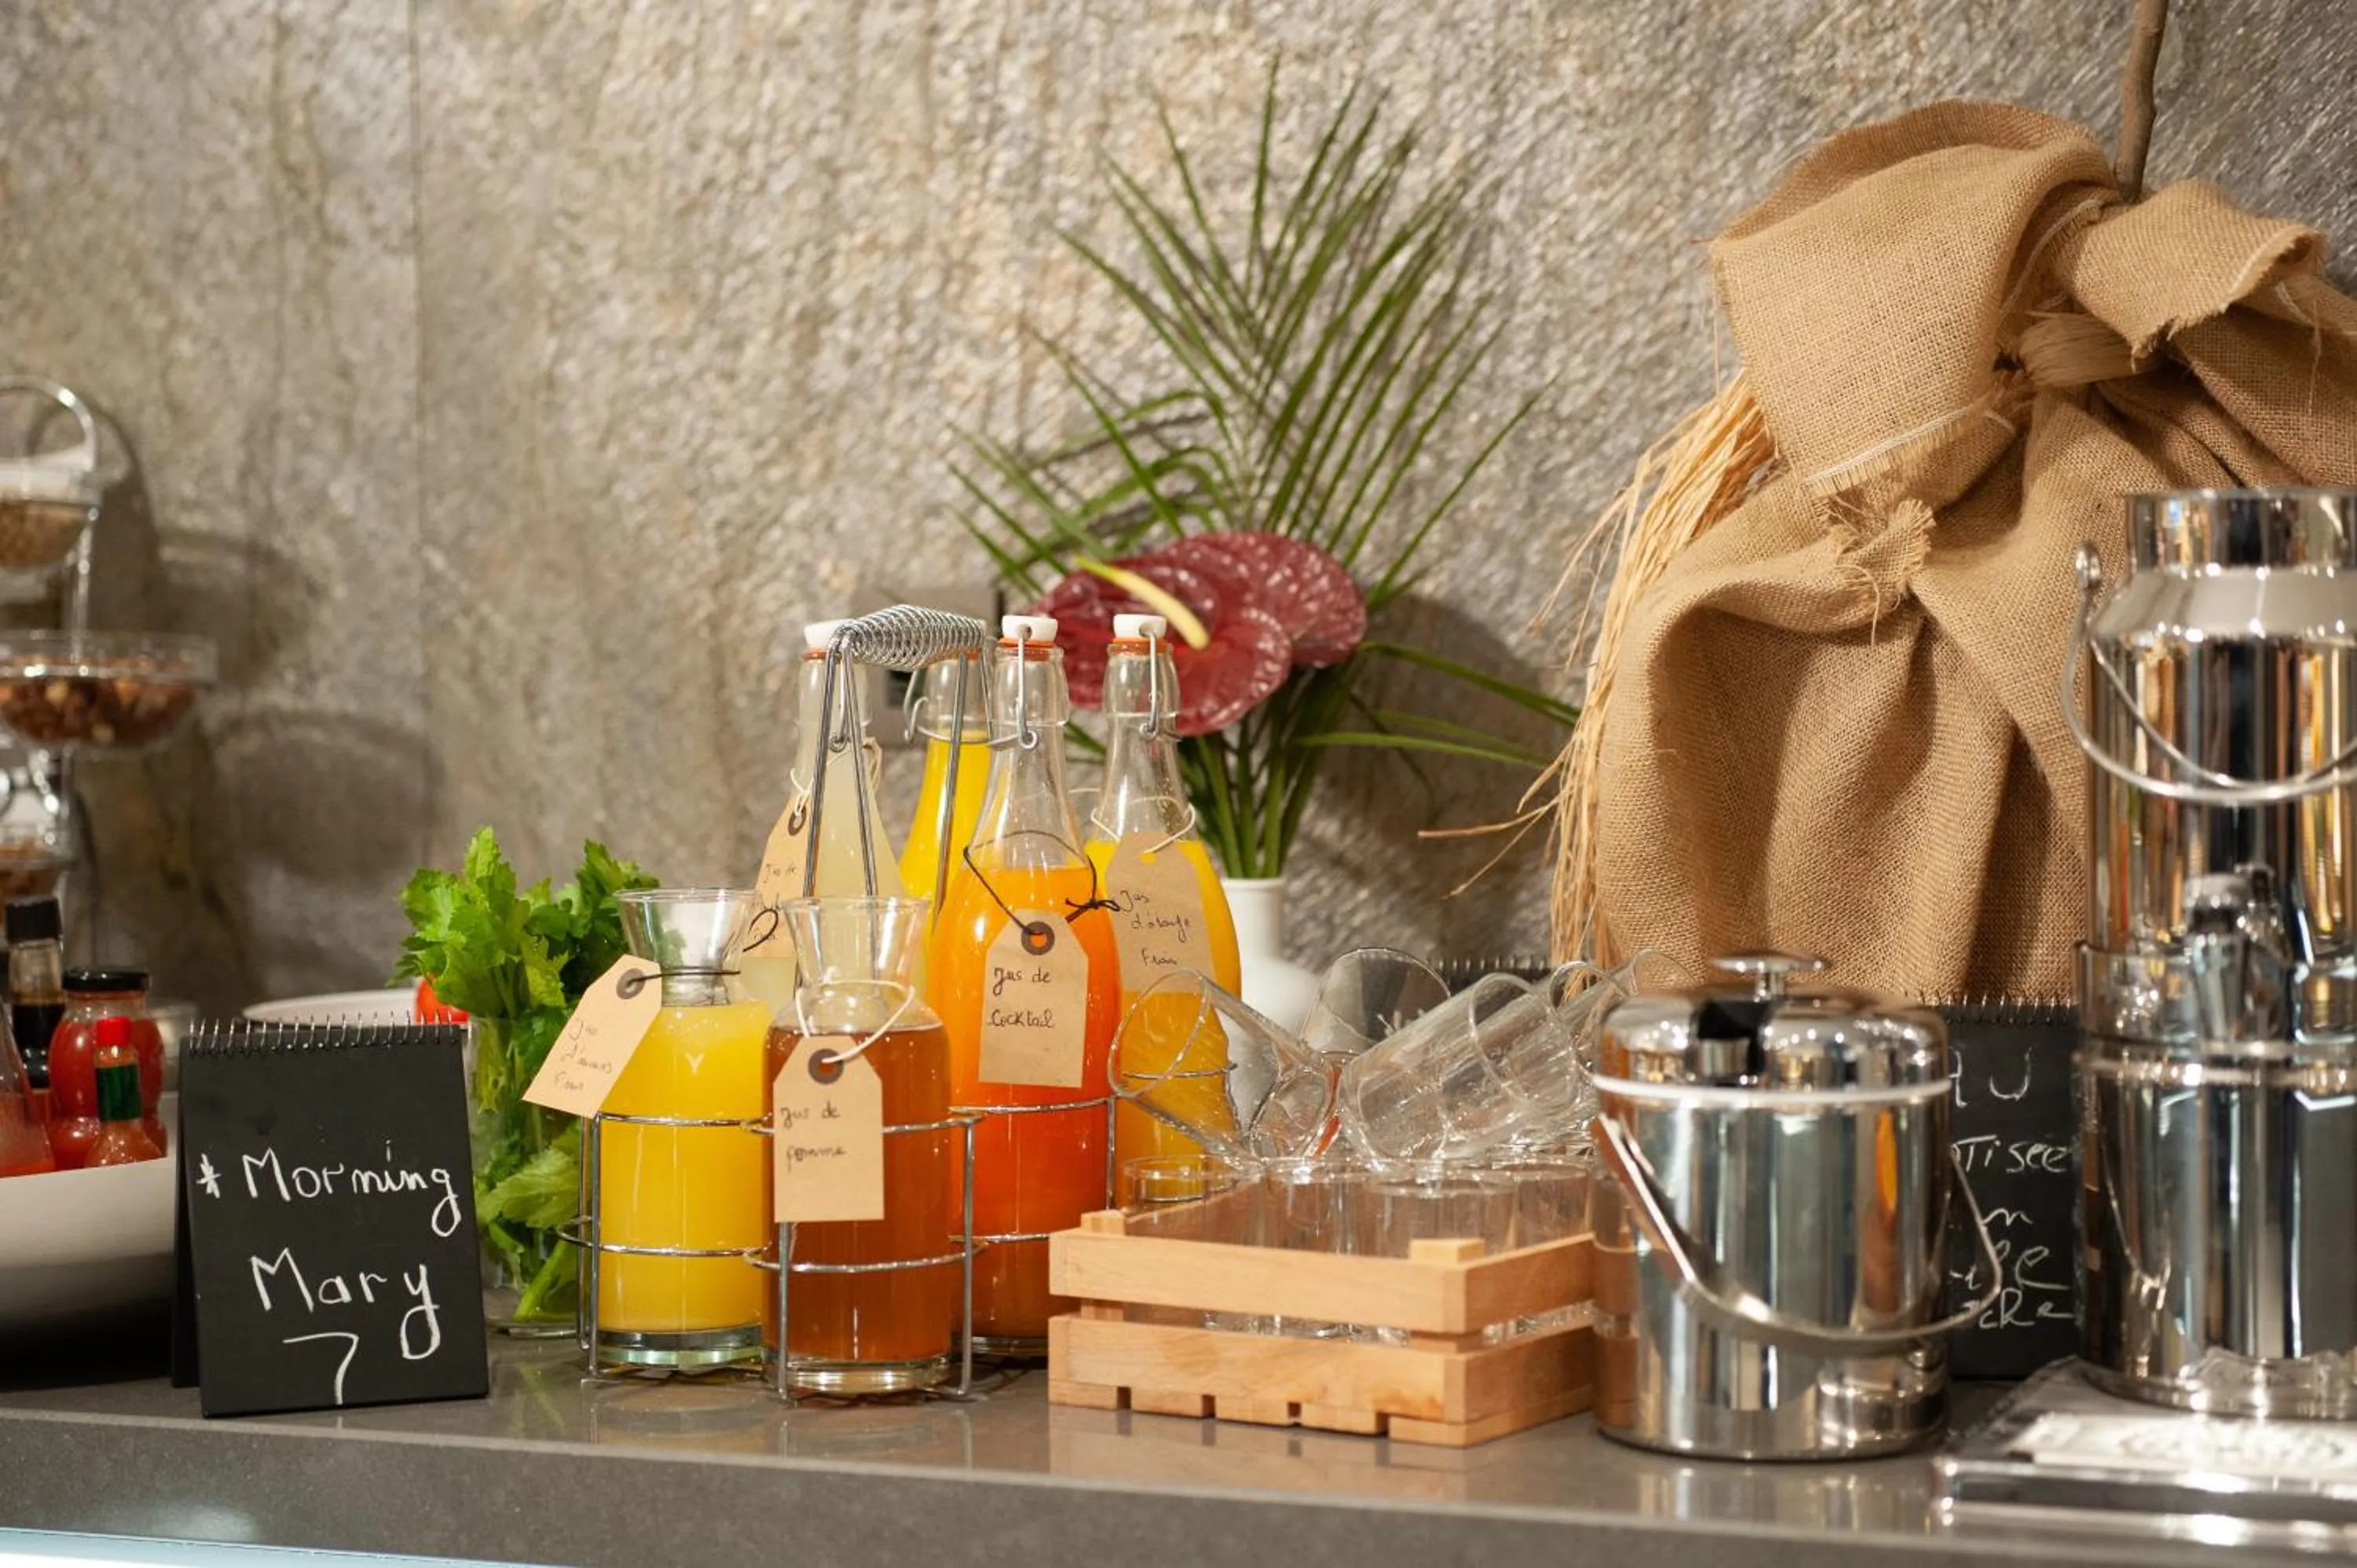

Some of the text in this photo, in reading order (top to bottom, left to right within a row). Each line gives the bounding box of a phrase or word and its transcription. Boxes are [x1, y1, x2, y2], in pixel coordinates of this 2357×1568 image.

[992, 965, 1051, 997] Jus de
[821, 1099, 841, 1119] de
[241, 1139, 462, 1237] Morning
[249, 1247, 441, 1361] Mary
